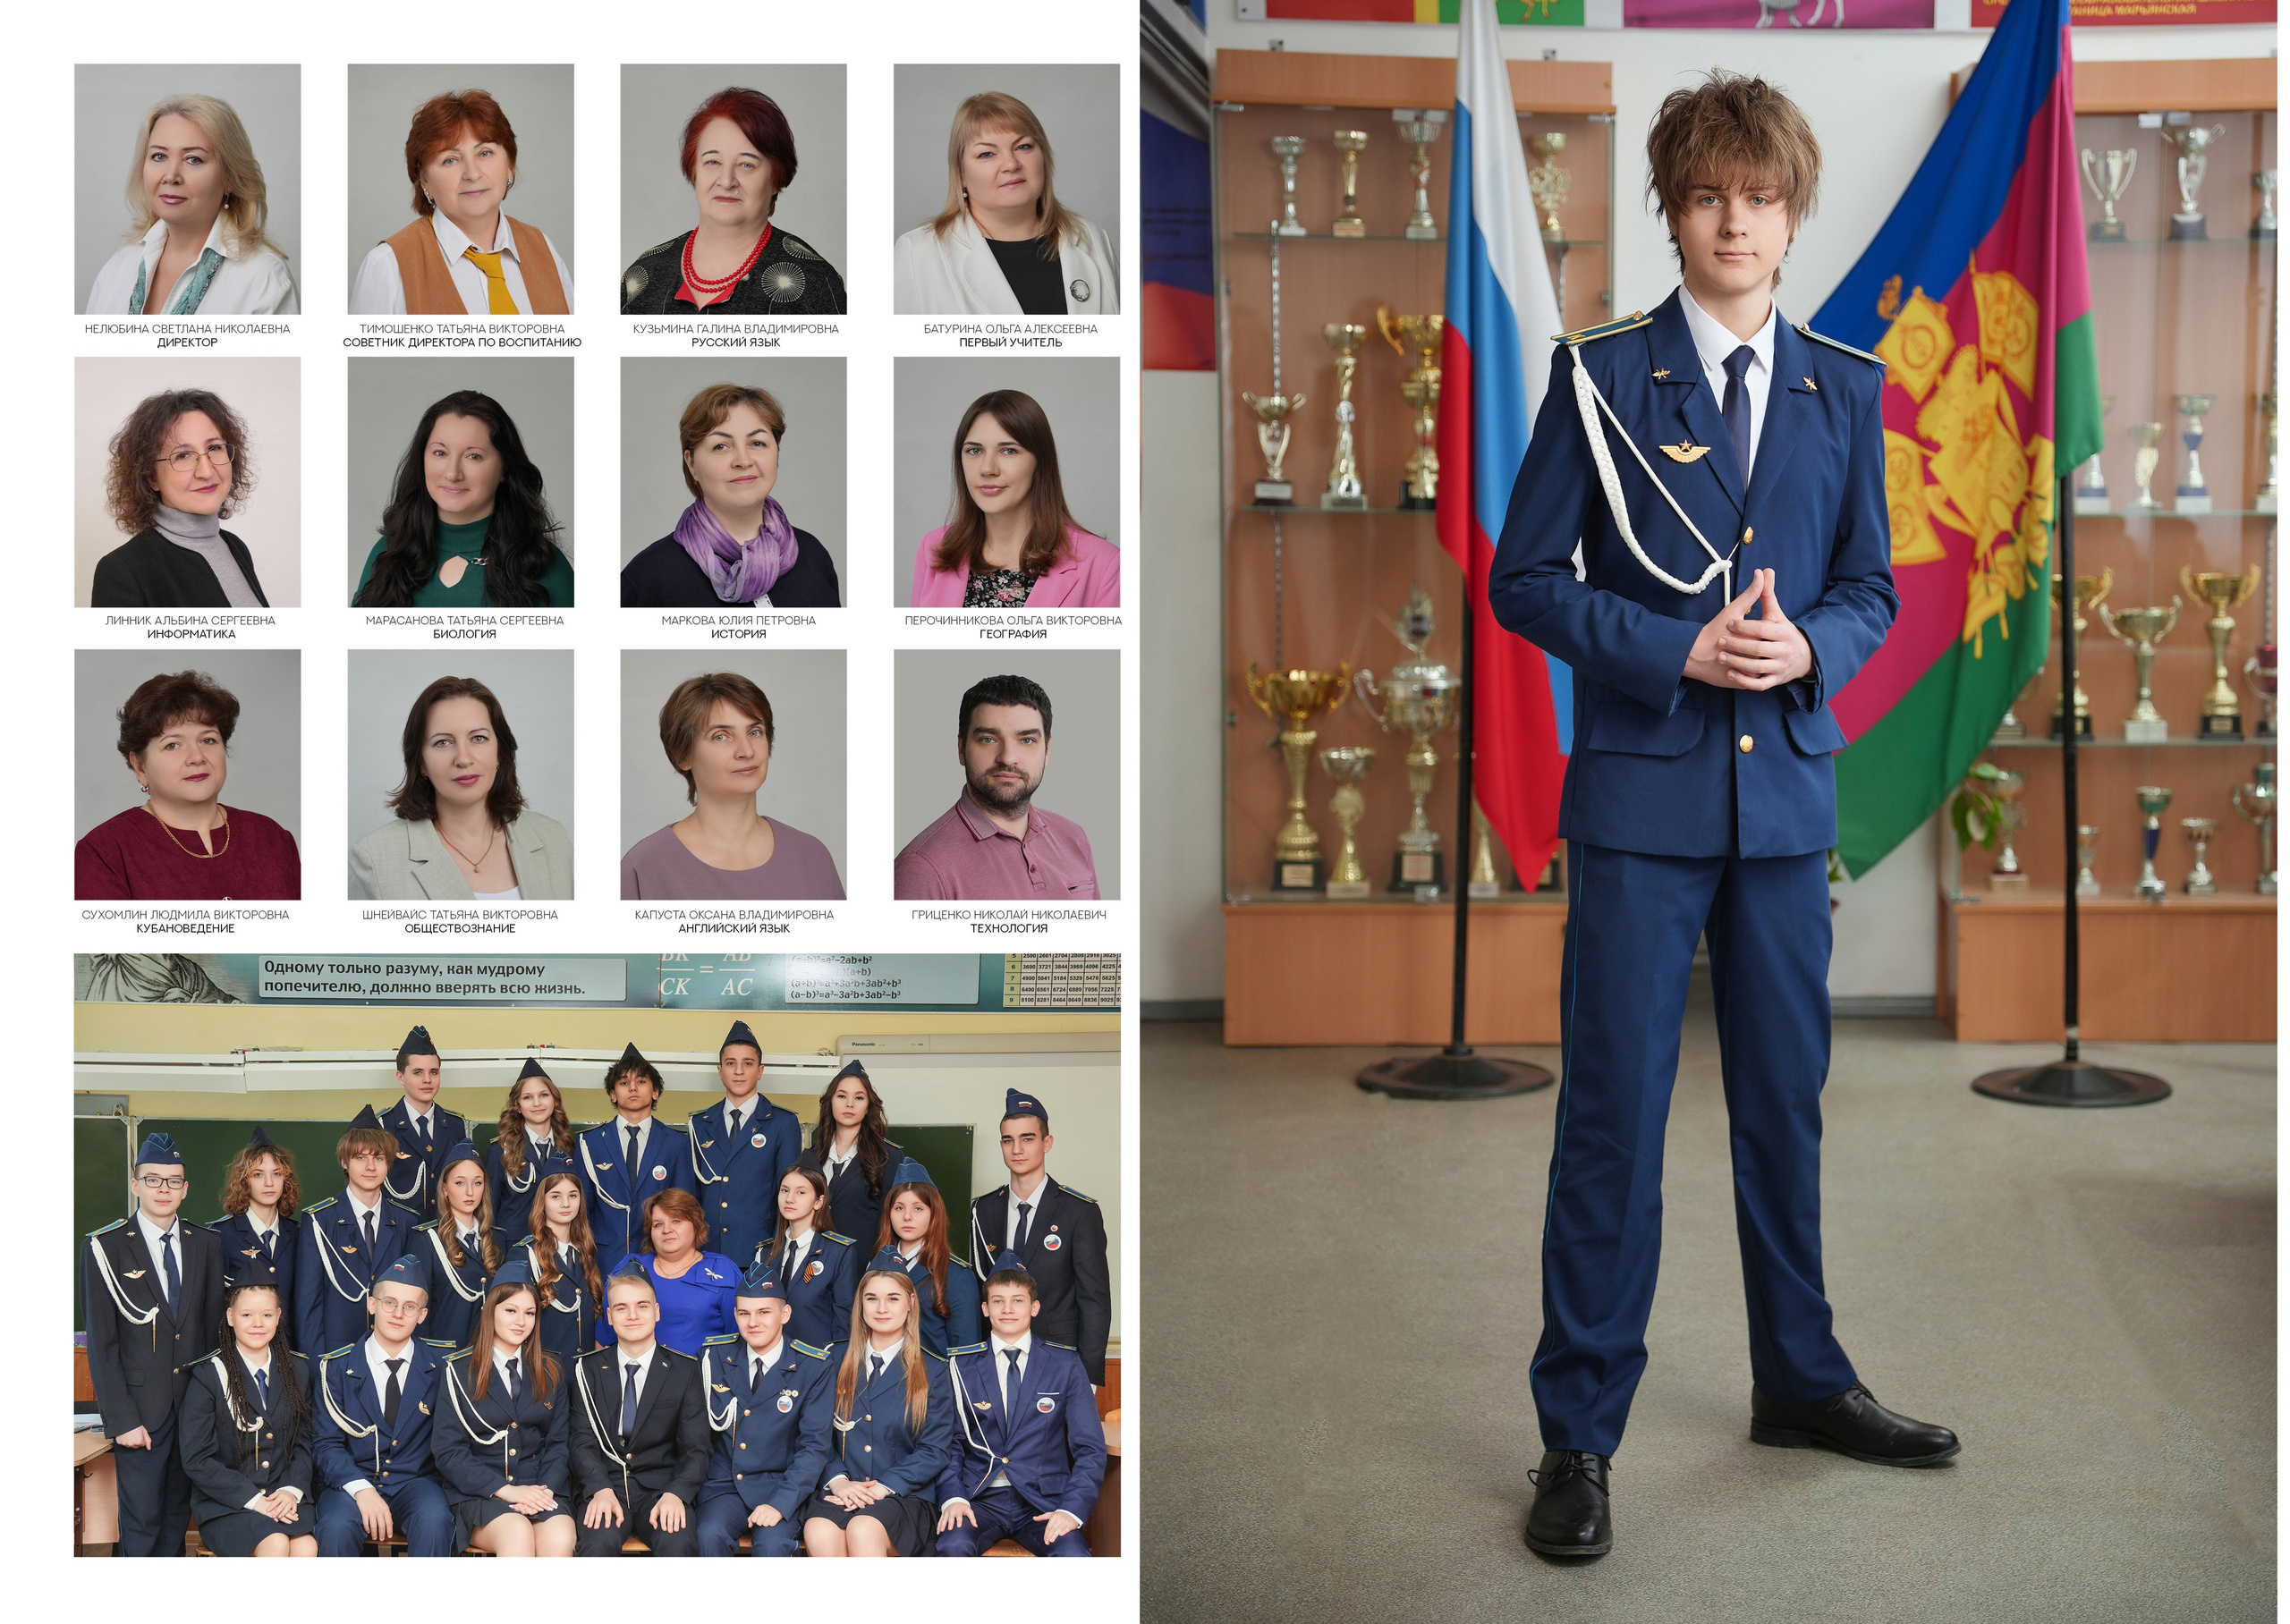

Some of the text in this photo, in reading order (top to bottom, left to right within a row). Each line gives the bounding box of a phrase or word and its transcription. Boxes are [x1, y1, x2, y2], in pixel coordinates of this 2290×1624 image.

[264, 960, 546, 977] Одному только разуму, как мудрому
[264, 981, 586, 995] попечителю, должно вверять всю жизнь.
[721, 977, 753, 995] AC
